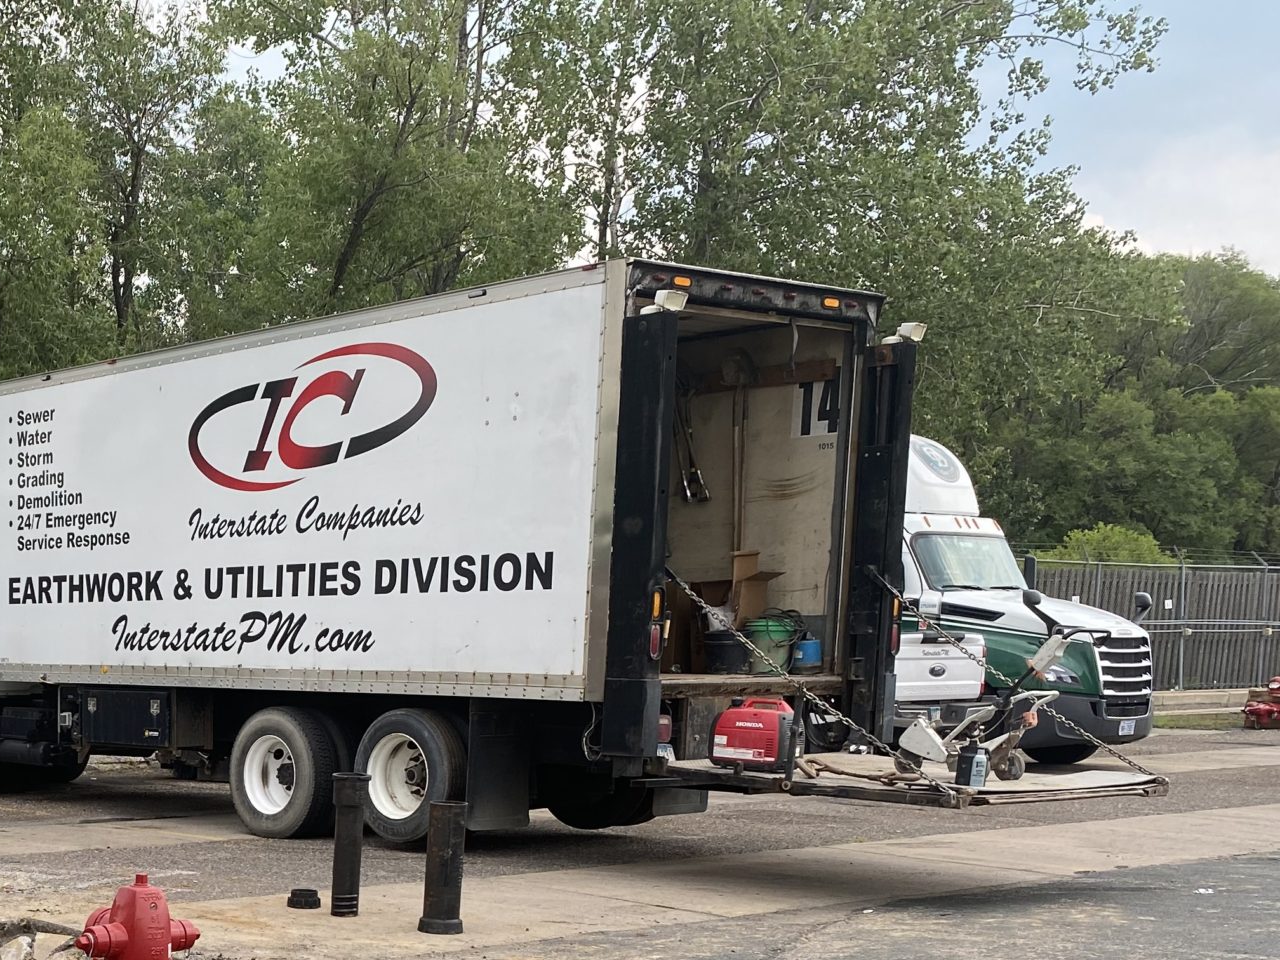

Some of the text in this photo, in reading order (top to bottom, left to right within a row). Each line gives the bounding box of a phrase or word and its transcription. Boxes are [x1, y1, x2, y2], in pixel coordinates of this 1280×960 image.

[17, 408, 55, 426] Sewer
[799, 381, 840, 436] 14
[17, 429, 53, 447] Water
[818, 442, 835, 451] 1015
[17, 451, 53, 468] Storm
[17, 470, 65, 489] Grading
[17, 490, 83, 510] Demolition
[17, 510, 117, 531] 24/7 Emergency
[188, 495, 424, 541] Interstate Companies
[17, 530, 131, 552] Service Response
[8, 551, 554, 605] EARTHWORK & UTILITIES DIVISION
[111, 610, 376, 655] InterstatePM.com
[735, 721, 764, 729] HONDA
